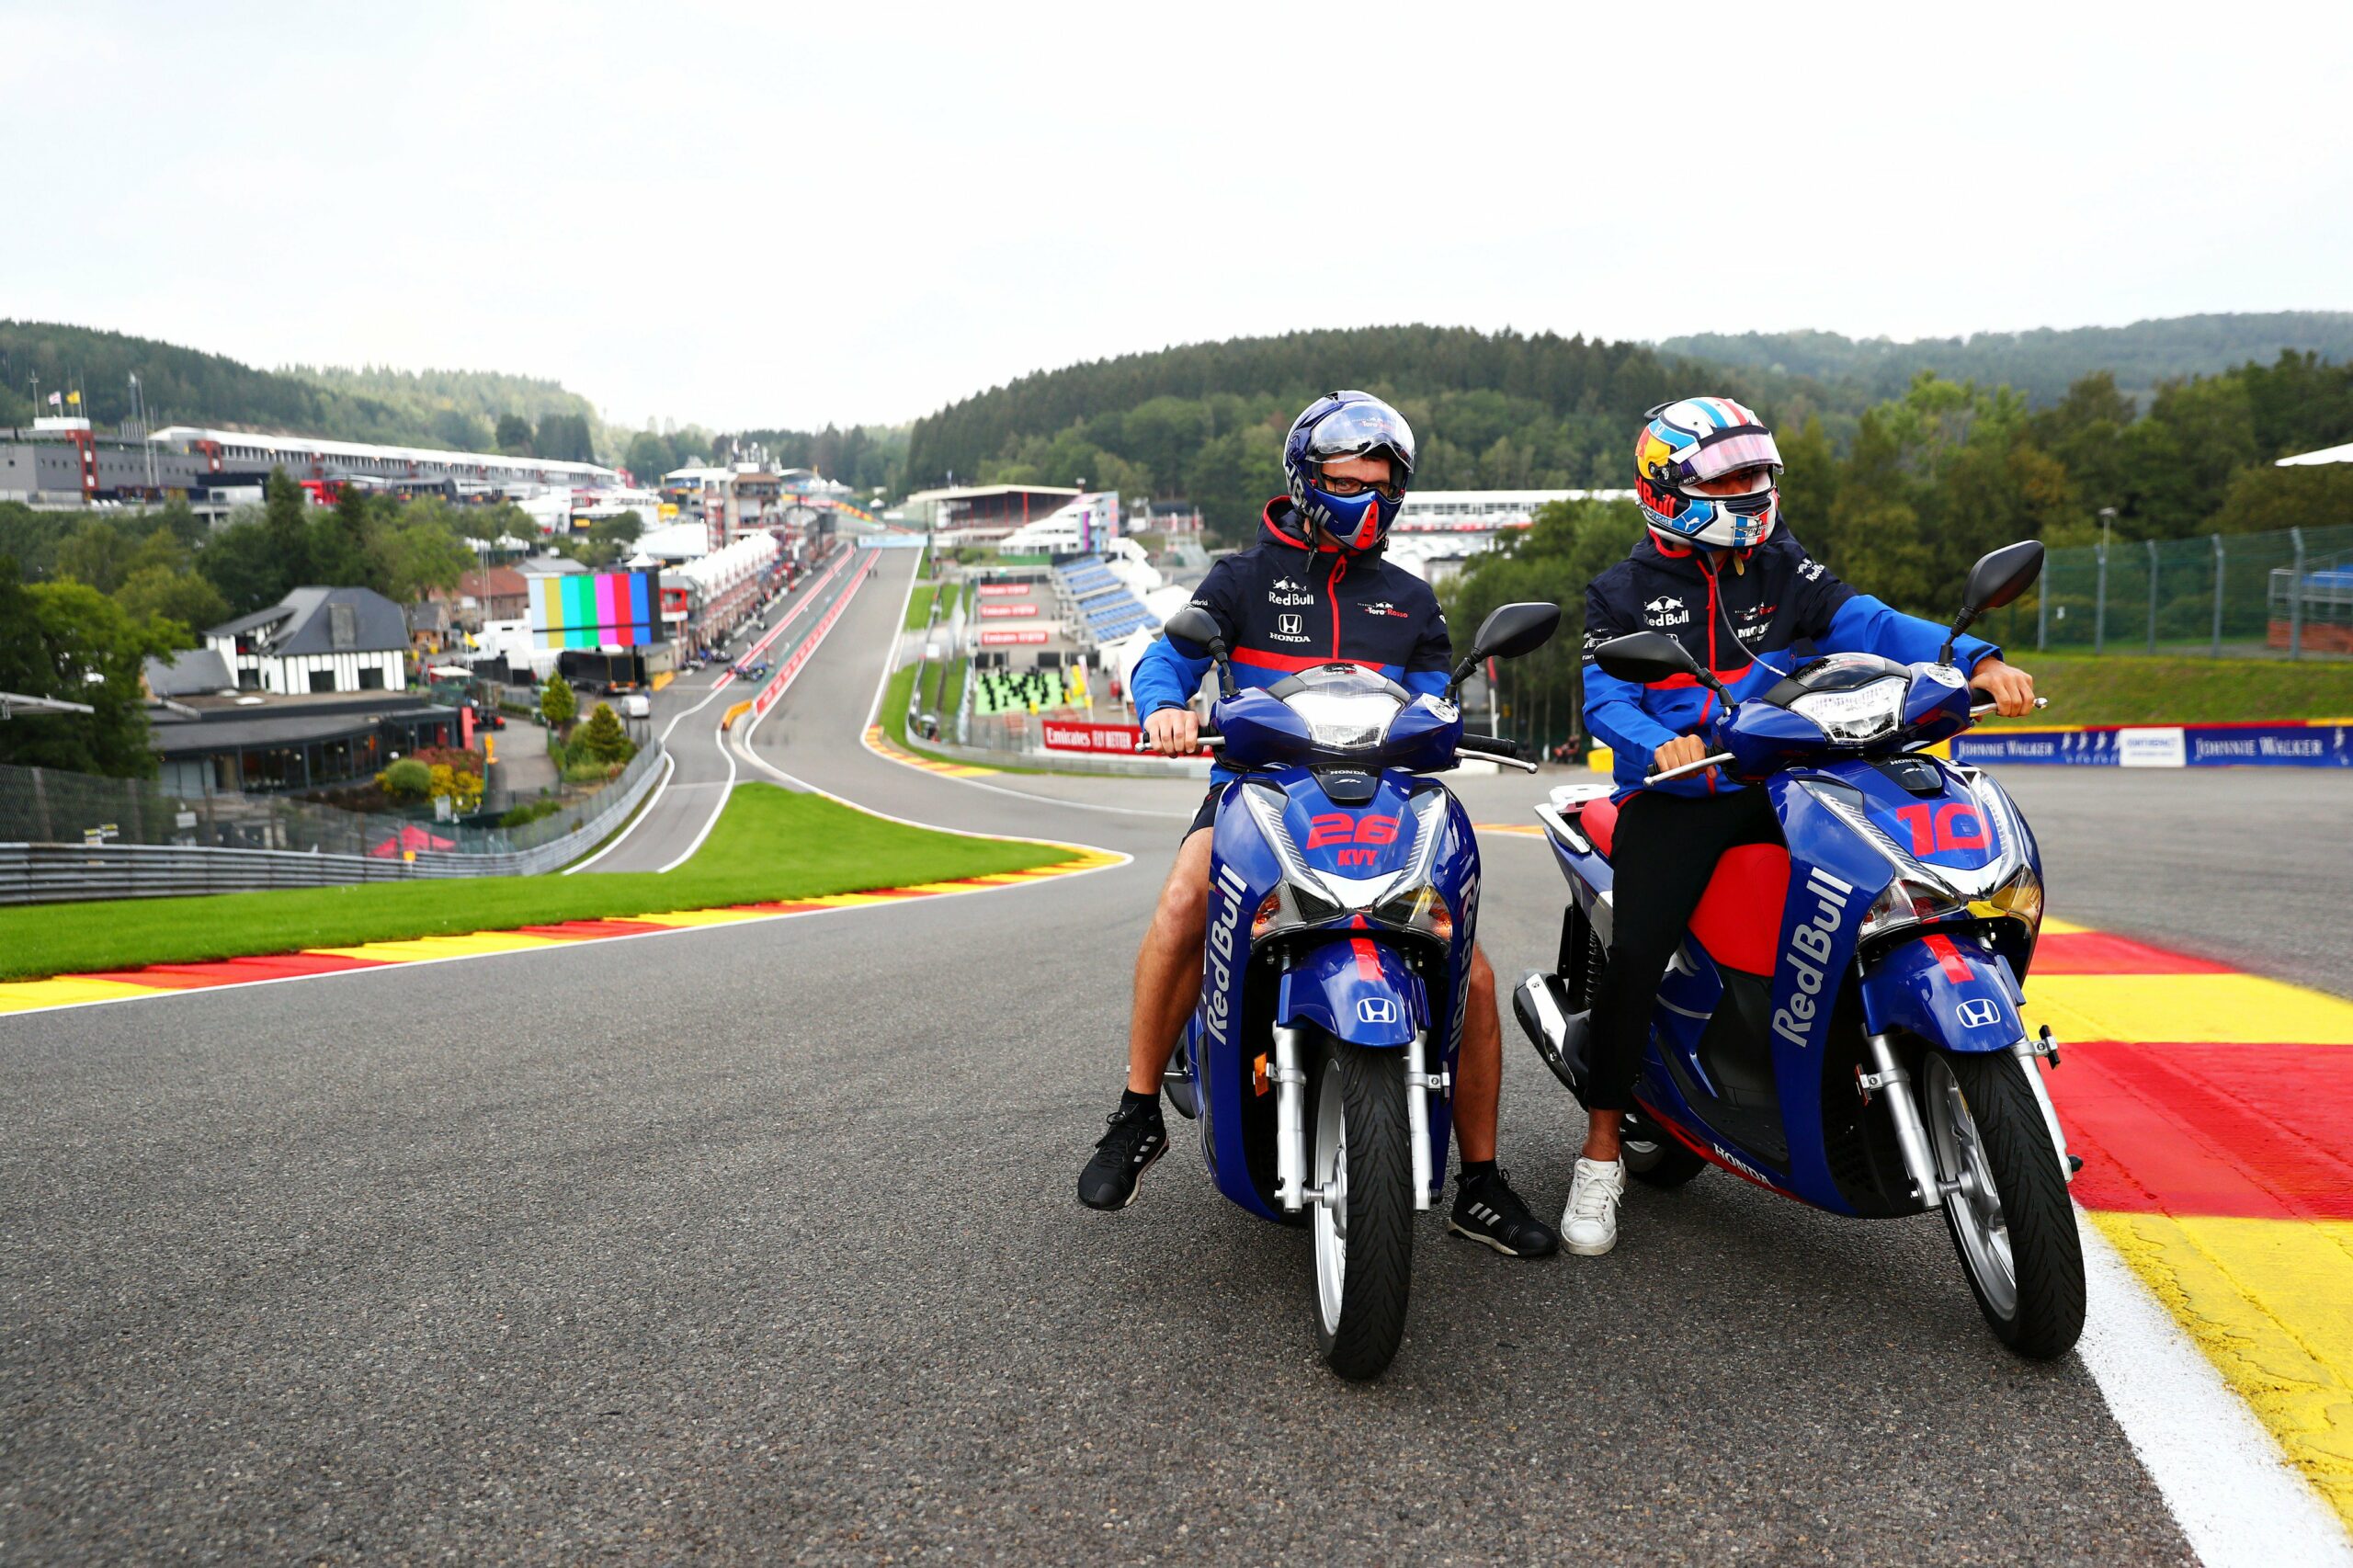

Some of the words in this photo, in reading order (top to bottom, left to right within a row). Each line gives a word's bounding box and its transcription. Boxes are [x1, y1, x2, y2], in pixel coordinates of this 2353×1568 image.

[1643, 481, 1677, 518] Bull
[1268, 591, 1290, 606] Red
[1292, 593, 1314, 606] Bull
[1368, 607, 1385, 616] Toro
[1269, 631, 1311, 642] HONDA
[1643, 613, 1665, 627] Red
[1665, 610, 1689, 626] Bull
[1306, 813, 1401, 850] 26
[1895, 802, 1993, 857] 10
[1337, 849, 1377, 866] KVY
[1211, 863, 1248, 962] Bull
[1791, 866, 1854, 965] Bull
[1207, 949, 1231, 1046] Red
[1772, 953, 1824, 1049] Red
[1713, 1142, 1777, 1189] HONDA
